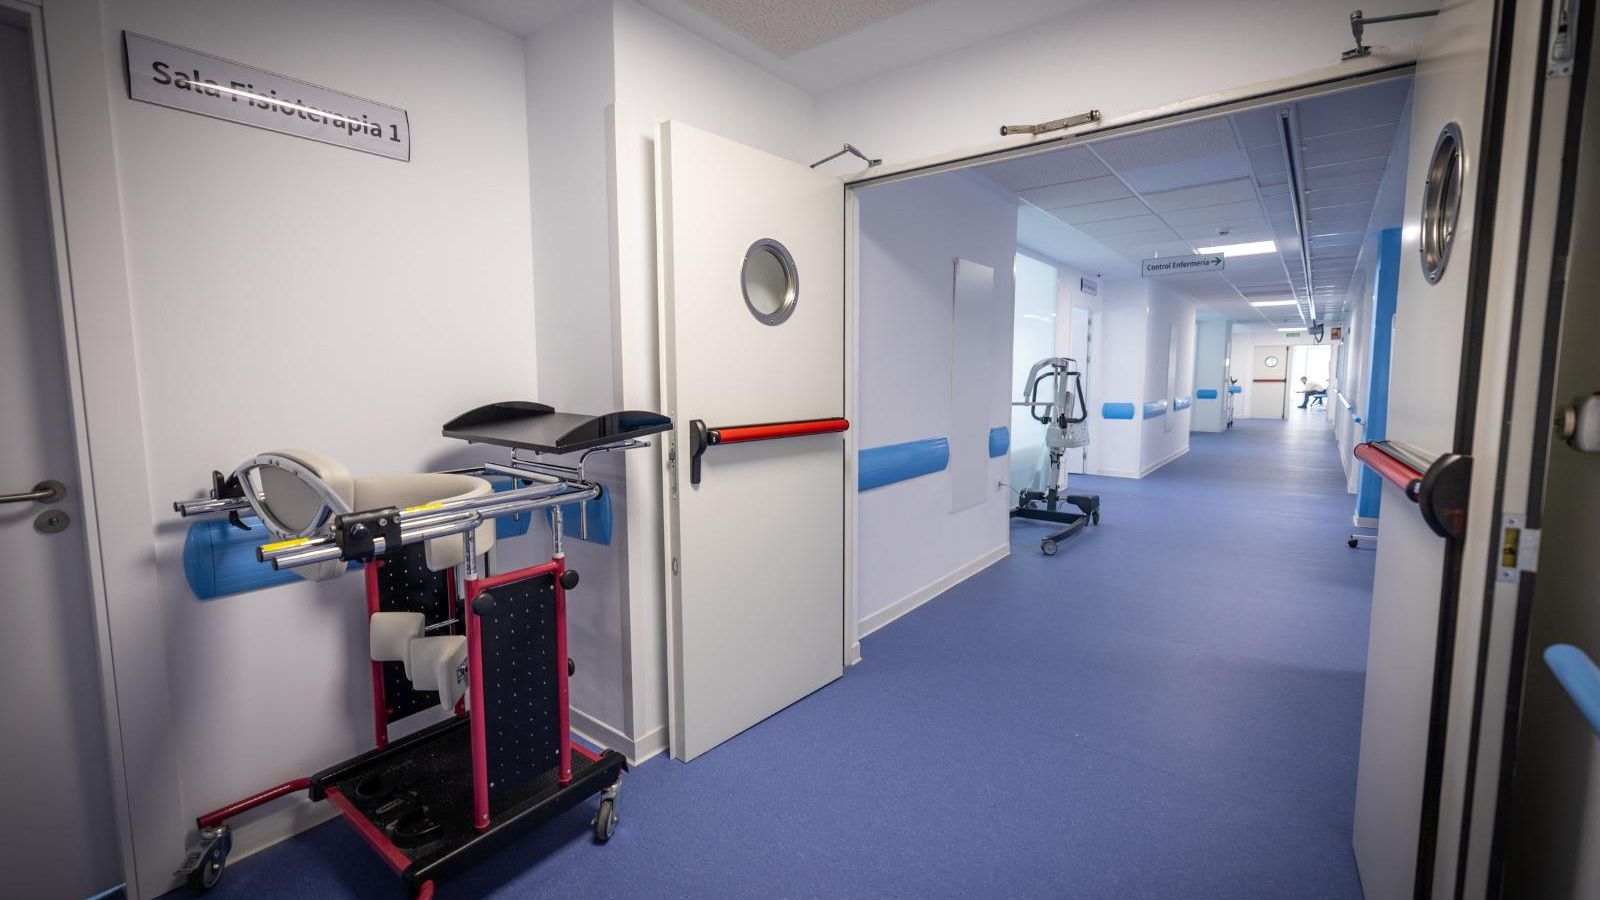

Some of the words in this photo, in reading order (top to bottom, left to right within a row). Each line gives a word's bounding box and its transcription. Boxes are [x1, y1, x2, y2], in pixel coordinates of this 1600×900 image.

[152, 61, 220, 98] Sala
[230, 81, 382, 138] Fisioterapia
[389, 124, 401, 142] 1
[1147, 262, 1171, 271] Control
